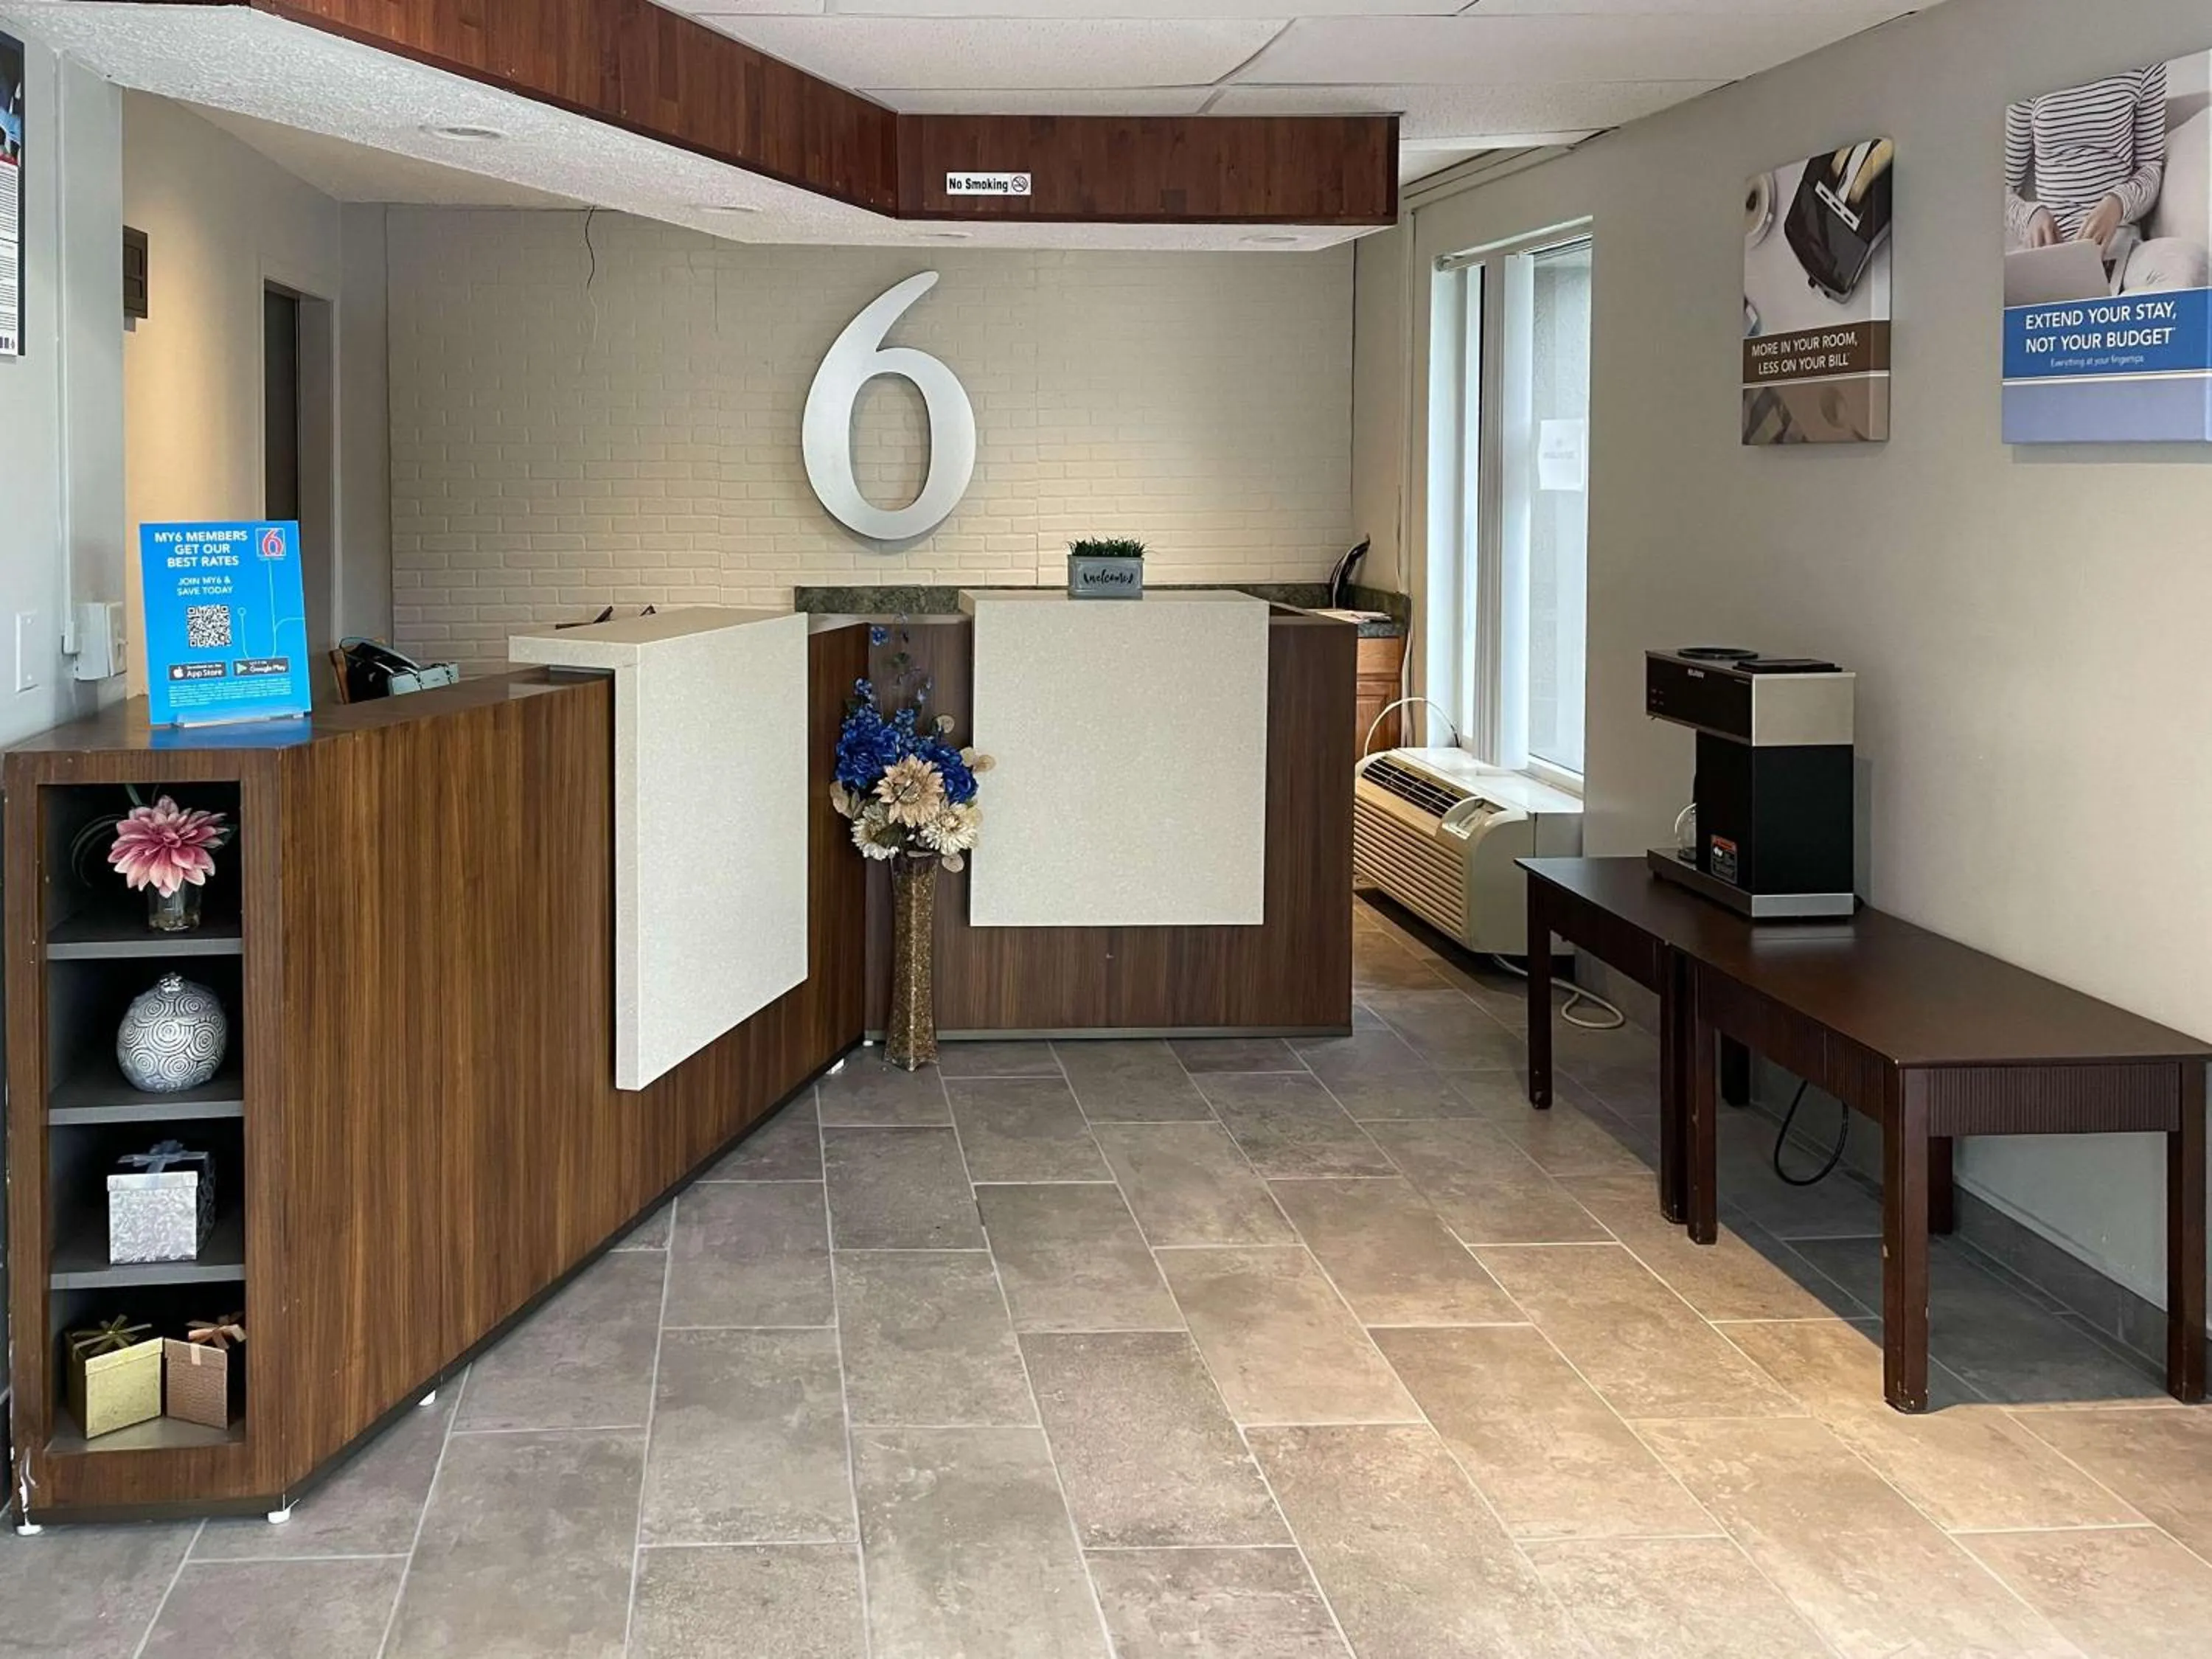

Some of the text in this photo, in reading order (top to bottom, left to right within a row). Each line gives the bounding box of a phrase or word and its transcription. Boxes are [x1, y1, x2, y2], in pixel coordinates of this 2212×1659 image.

[949, 178, 1008, 192] No Smoking
[2025, 301, 2177, 330] EXTEND YOUR STAY,
[1751, 332, 1857, 357] MORE IN YOUR ROOM,
[2025, 327, 2171, 353] NOT YOUR BUDGET
[1759, 353, 1848, 375] LESS ON YOUR BILL
[802, 271, 976, 540] 6
[154, 530, 248, 543] MY6 MEMBERS
[262, 529, 285, 555] 6
[175, 543, 230, 555] GET OUR
[167, 555, 240, 568] BEST RATES
[178, 576, 231, 586] JOIN MY6 &
[177, 586, 233, 597] SAVE TODAY
[187, 668, 223, 678] App Store
[250, 665, 271, 673] Google
